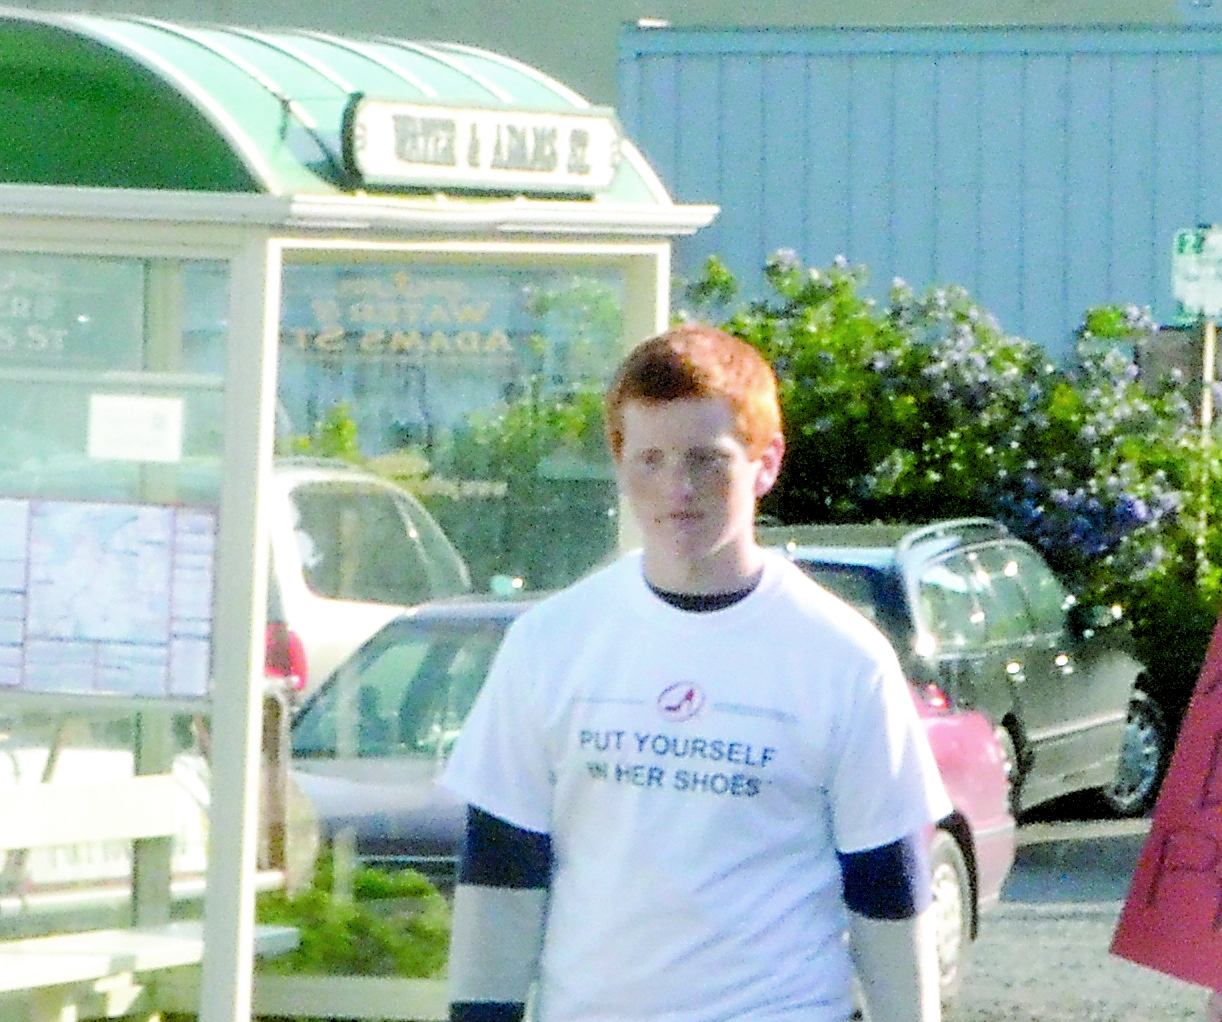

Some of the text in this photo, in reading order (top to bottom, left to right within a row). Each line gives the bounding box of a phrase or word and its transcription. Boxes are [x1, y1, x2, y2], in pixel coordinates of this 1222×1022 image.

[579, 729, 776, 768] PUT YOURSELF
[614, 763, 665, 788] HER
[673, 769, 762, 798] SHOES
